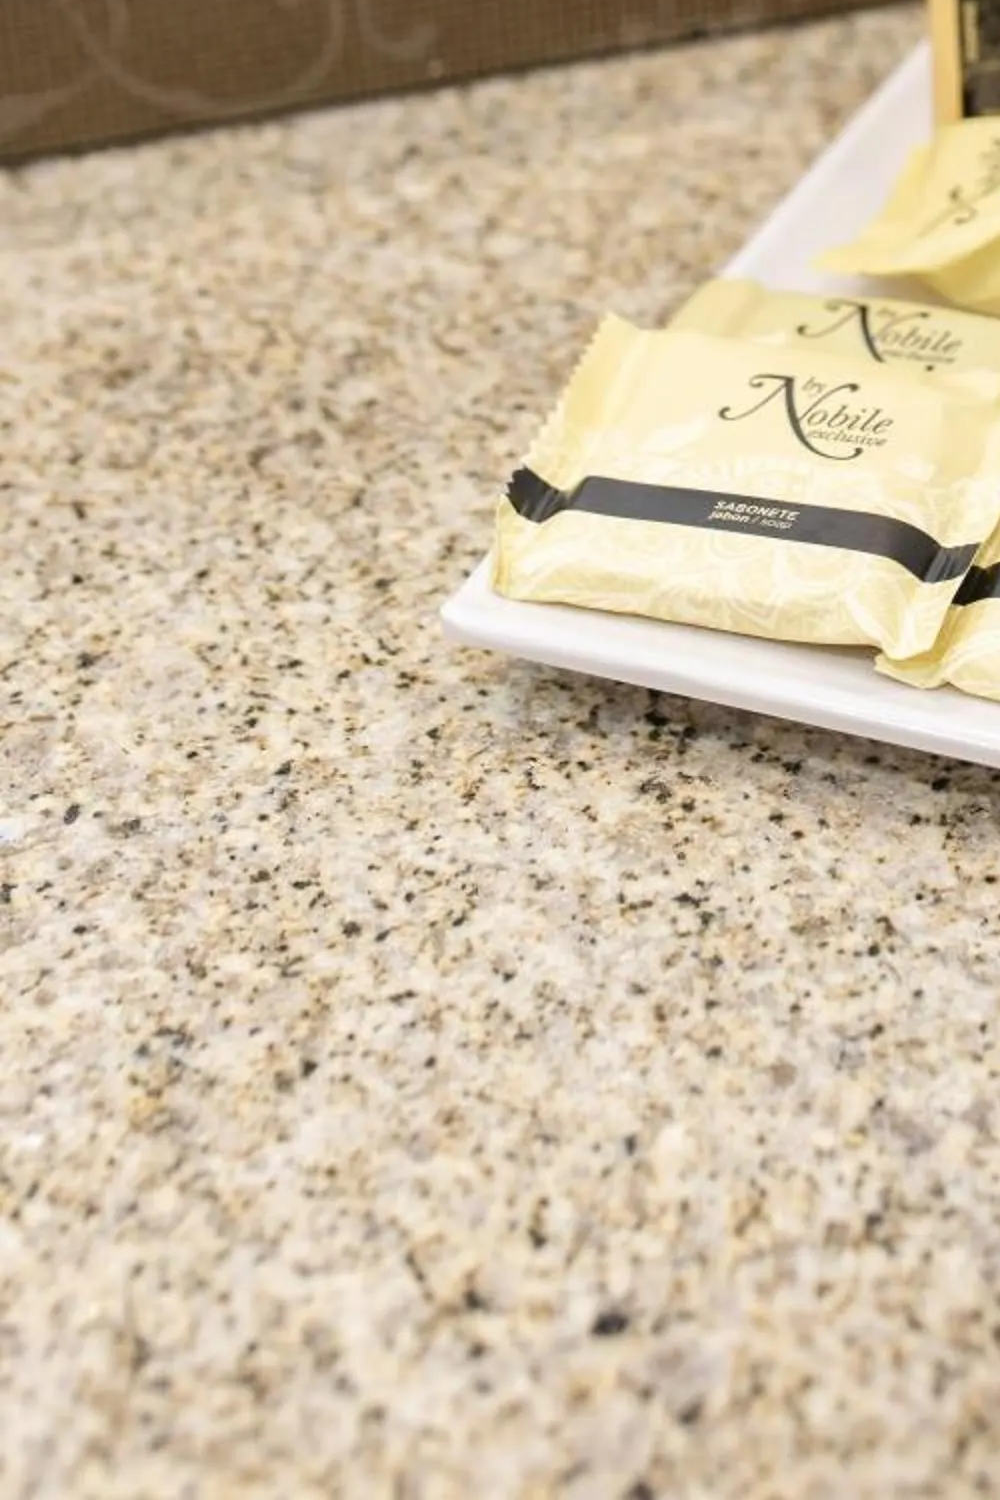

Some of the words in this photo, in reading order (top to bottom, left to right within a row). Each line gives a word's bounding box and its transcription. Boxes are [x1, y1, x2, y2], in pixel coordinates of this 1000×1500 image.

[797, 298, 962, 373] Nobile
[801, 376, 827, 398] by
[718, 373, 894, 461] Nobile
[806, 428, 889, 448] exclusive
[714, 500, 800, 521] SABONETE
